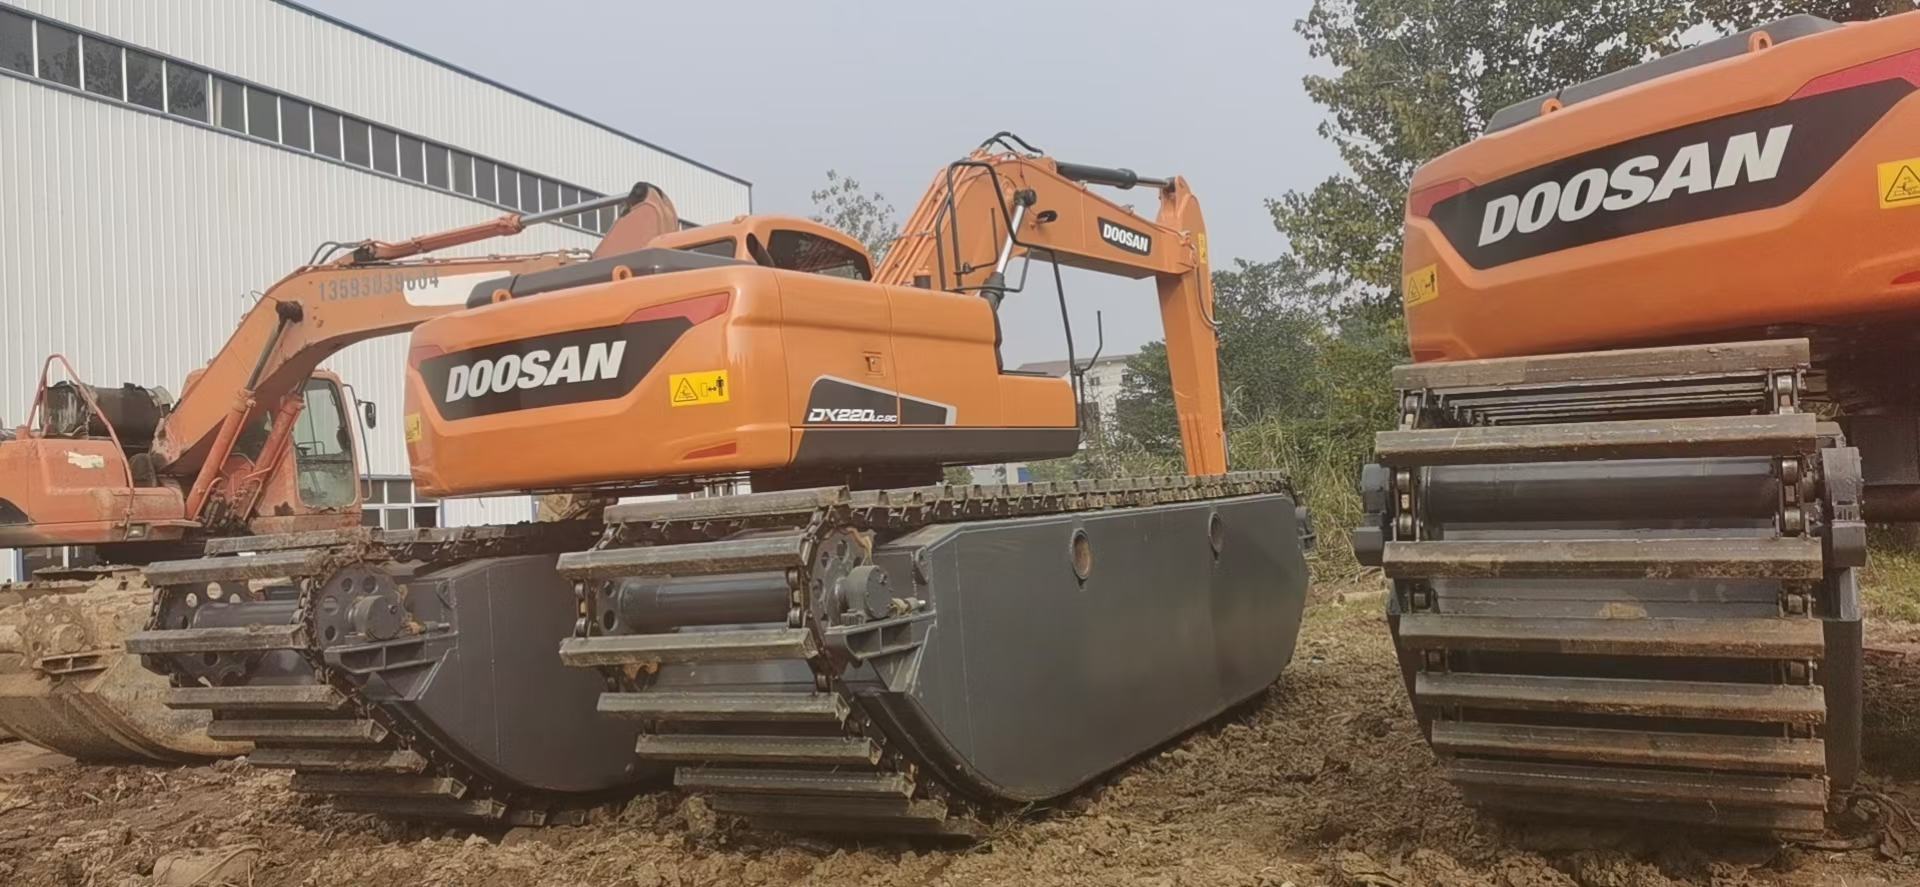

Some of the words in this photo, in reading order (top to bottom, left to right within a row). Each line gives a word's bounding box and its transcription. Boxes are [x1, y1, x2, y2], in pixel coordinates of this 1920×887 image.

[1478, 124, 1793, 247] DOOSAN
[1103, 223, 1149, 252] DOOSAN
[445, 340, 627, 403] DOOSAN
